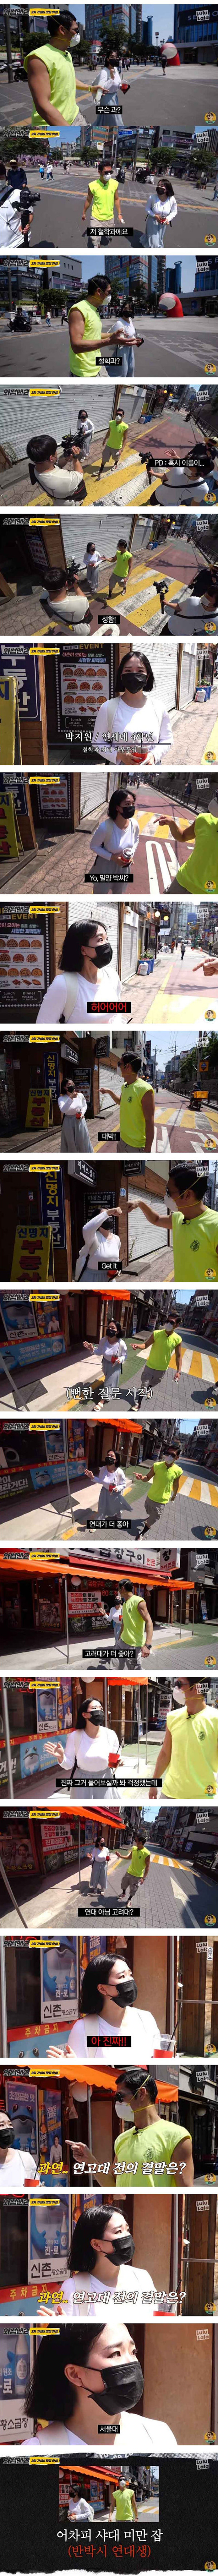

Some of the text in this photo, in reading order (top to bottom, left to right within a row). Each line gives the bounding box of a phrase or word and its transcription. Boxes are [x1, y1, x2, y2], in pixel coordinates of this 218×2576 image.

[47, 1055, 56, 1077] 신명지
[45, 1171, 58, 1207] 신명지
[18, 1227, 48, 1238] 신명지
[146, 1558, 156, 1567] 전문
[43, 2004, 62, 2019] 신촌
[25, 2023, 58, 2037] 주차금지
[9, 2091, 35, 2102] 초깔끔한 맛
[31, 2262, 52, 2278] 신촌
[10, 2284, 47, 2300] 주차금지
[3, 2367, 12, 2376] 원조
[0, 2418, 29, 2431] 황소곱창
